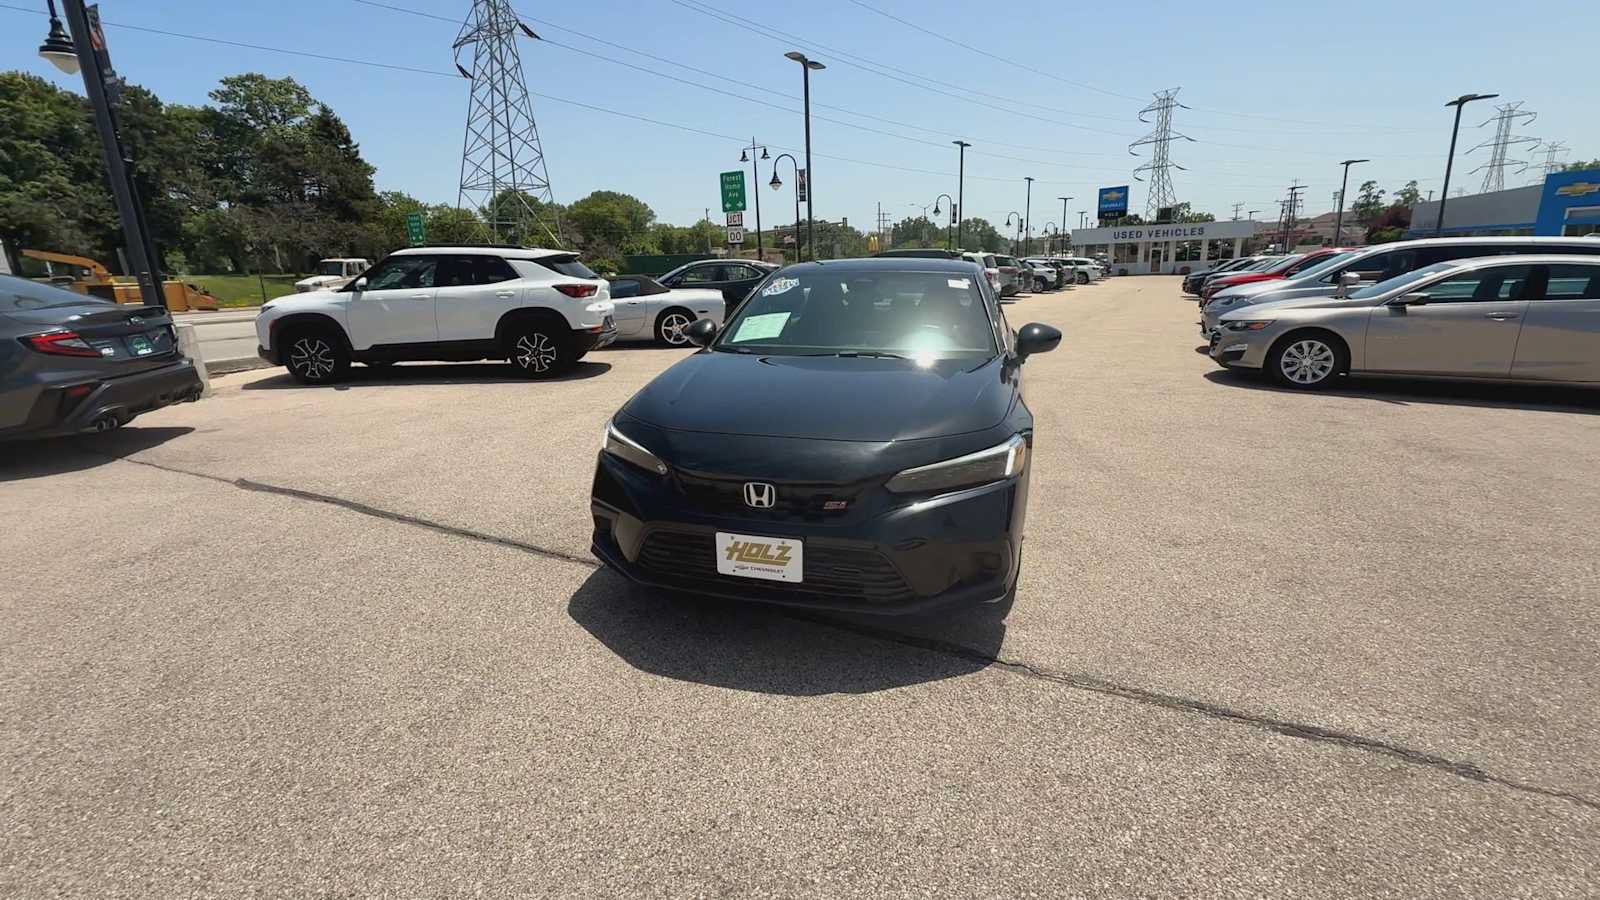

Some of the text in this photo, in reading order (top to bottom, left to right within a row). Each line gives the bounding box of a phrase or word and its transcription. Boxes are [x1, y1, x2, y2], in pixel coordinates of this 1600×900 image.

[728, 214, 741, 223] JCT
[1113, 227, 1205, 240] USED VEHICLES
[725, 540, 793, 563] HOLZ
